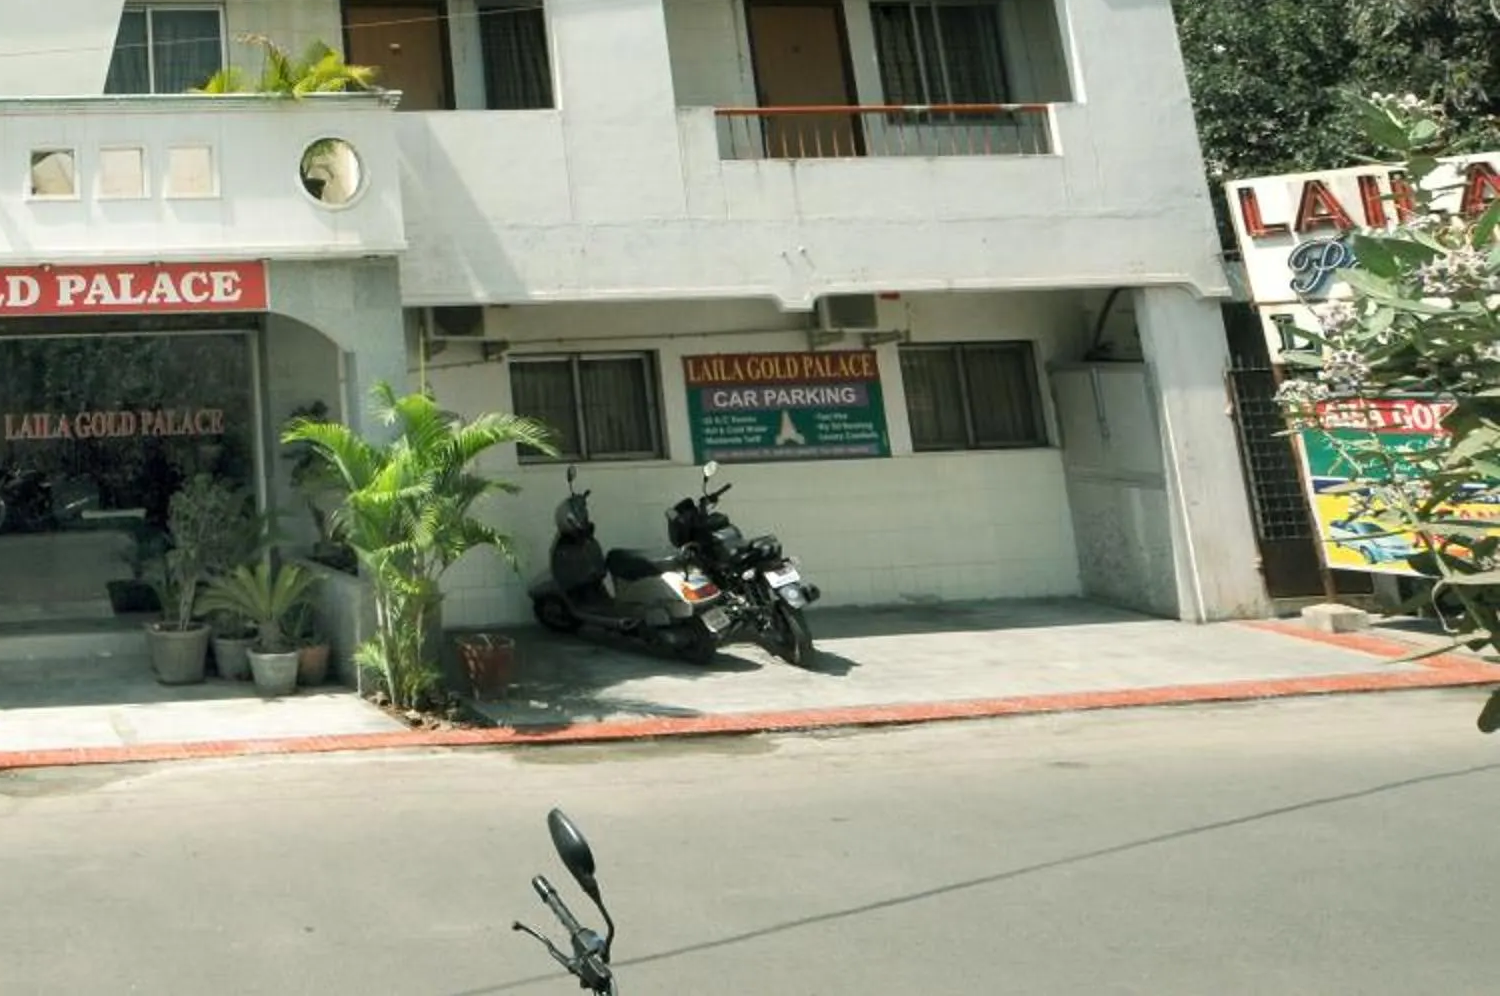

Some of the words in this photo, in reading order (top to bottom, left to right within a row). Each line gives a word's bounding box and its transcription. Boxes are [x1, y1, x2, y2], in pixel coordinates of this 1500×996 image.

[56, 270, 242, 306] PALACE
[686, 357, 744, 382] LAILA
[746, 355, 799, 380] GOLD
[802, 352, 875, 378] PALACE
[713, 389, 758, 408] CAR
[764, 386, 857, 406] PARKING
[4, 413, 73, 441] LAILA
[74, 411, 138, 439] GOLD
[140, 408, 225, 436] PALACE
